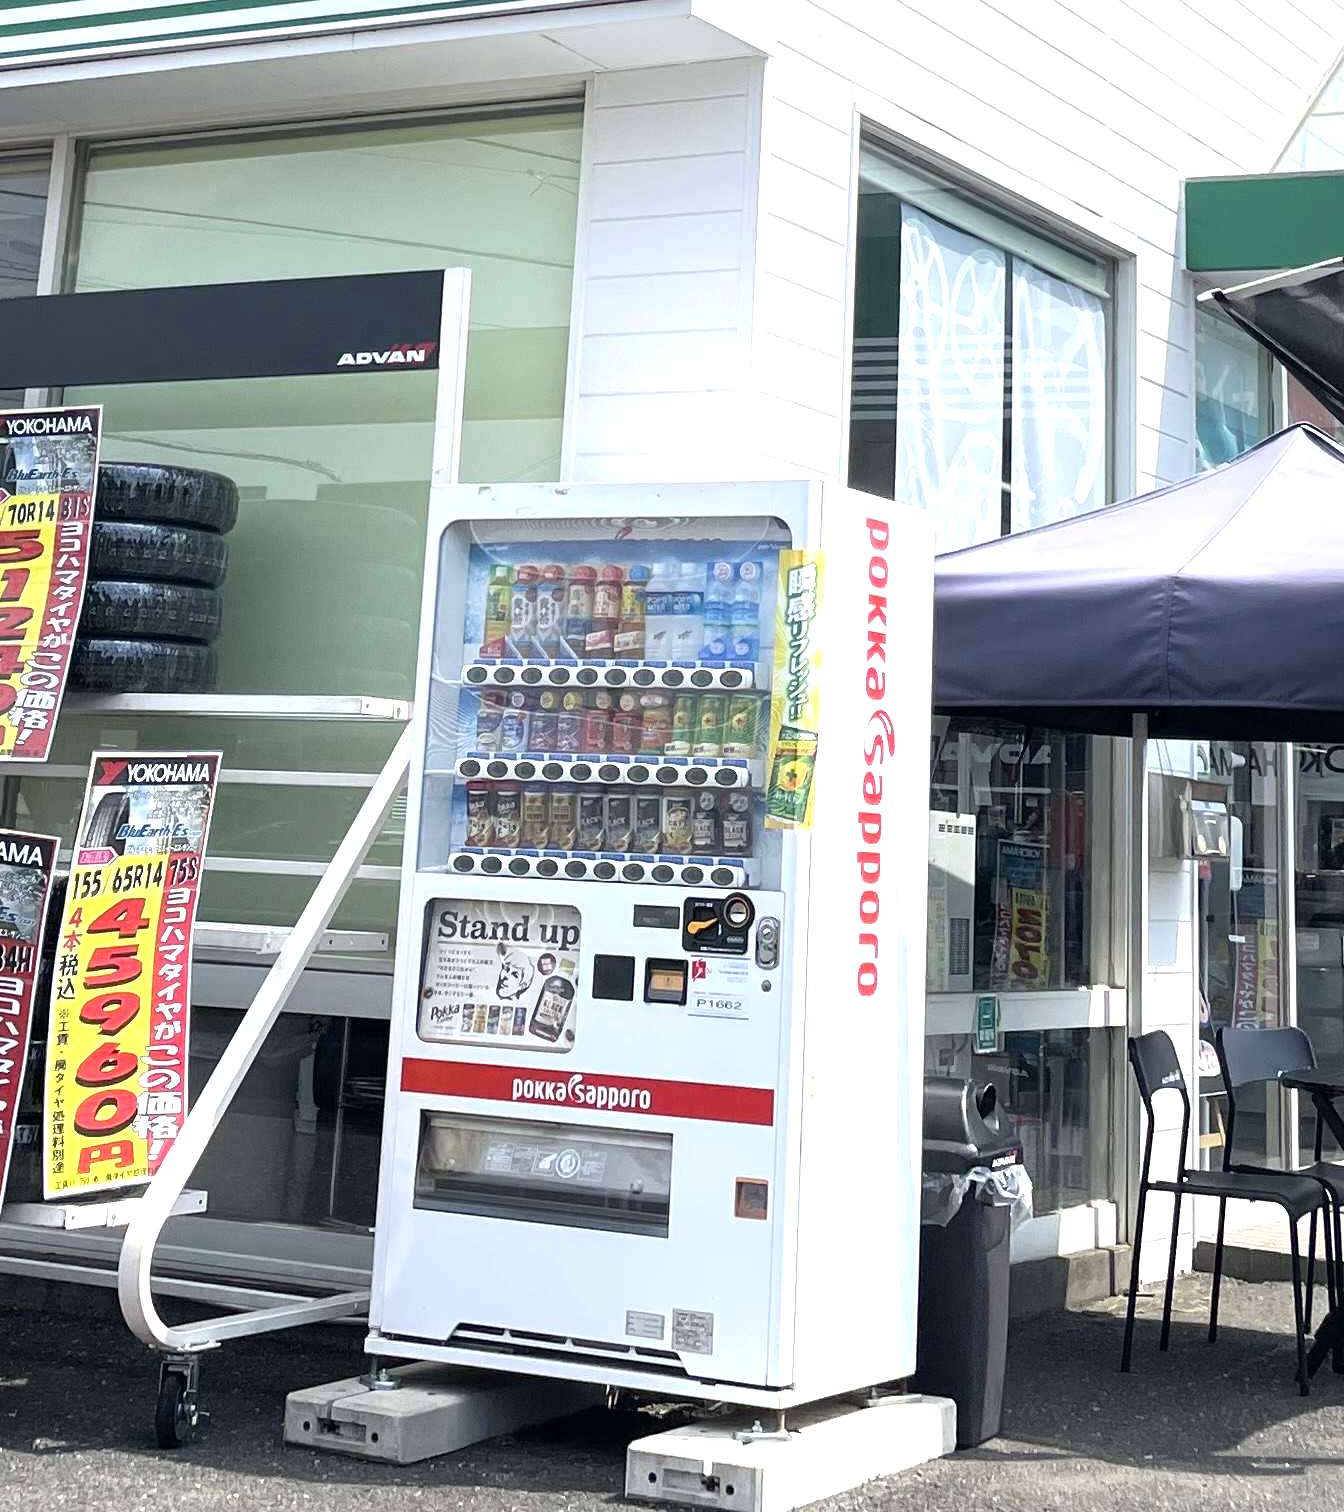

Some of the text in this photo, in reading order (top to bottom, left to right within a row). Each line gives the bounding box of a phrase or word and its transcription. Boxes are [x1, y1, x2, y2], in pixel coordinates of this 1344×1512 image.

[337, 347, 427, 367] ADVAN
[7, 416, 92, 435] YOKOHAMA
[127, 762, 209, 783] YOKOHAMA
[72, 860, 163, 900] 155/65R14
[438, 910, 581, 951] Stand up
[57, 908, 83, 999] 4本税込
[74, 897, 150, 1175] 45960円
